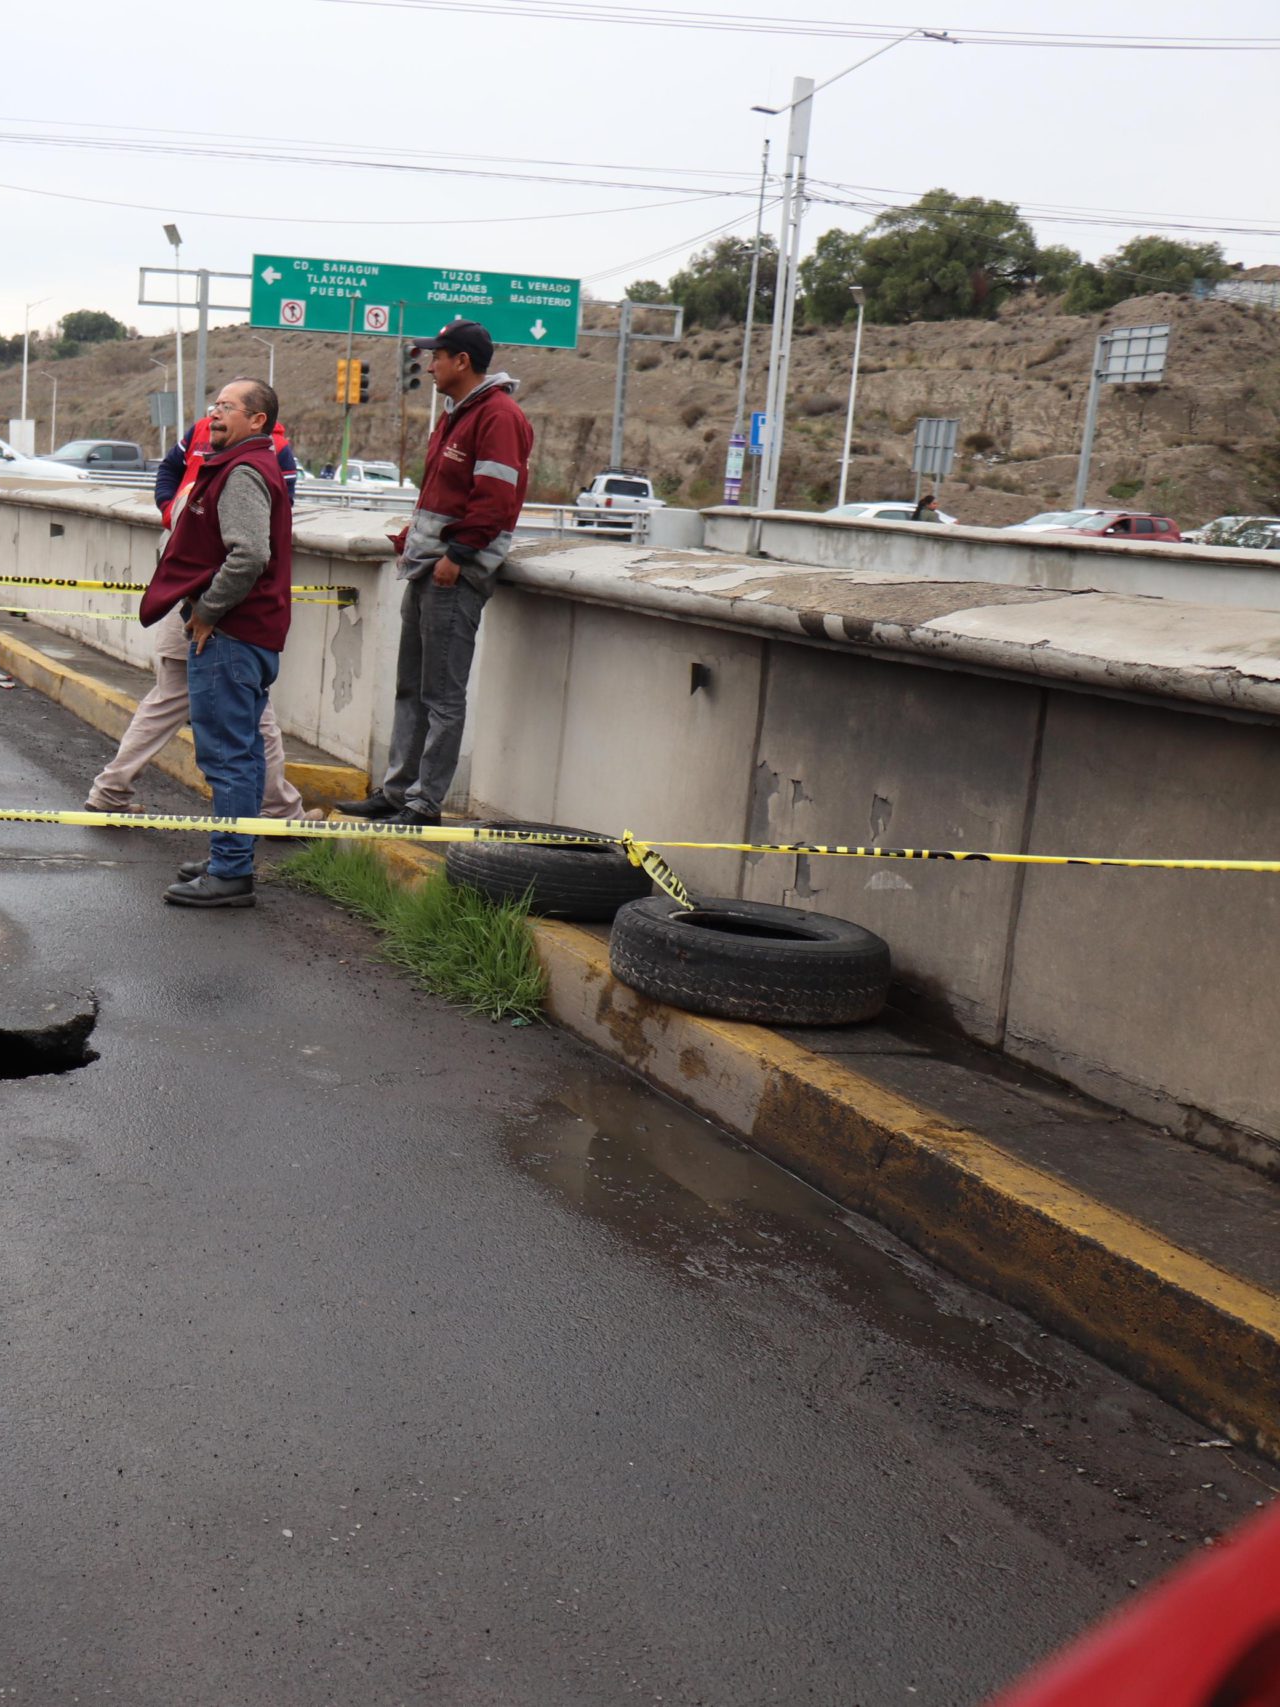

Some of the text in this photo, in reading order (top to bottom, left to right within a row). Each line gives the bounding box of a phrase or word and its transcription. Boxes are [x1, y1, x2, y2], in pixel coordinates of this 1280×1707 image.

[293, 261, 379, 275] CD. SAHAGUN
[307, 274, 367, 287] TLAXCALA
[441, 271, 481, 282] TUZOS
[310, 286, 362, 298] PUEBLA
[433, 281, 487, 294] TULIPANES
[510, 280, 571, 293] EL VENADO
[427, 292, 493, 305] FORJADORES
[510, 294, 571, 307] MAGISTERIO
